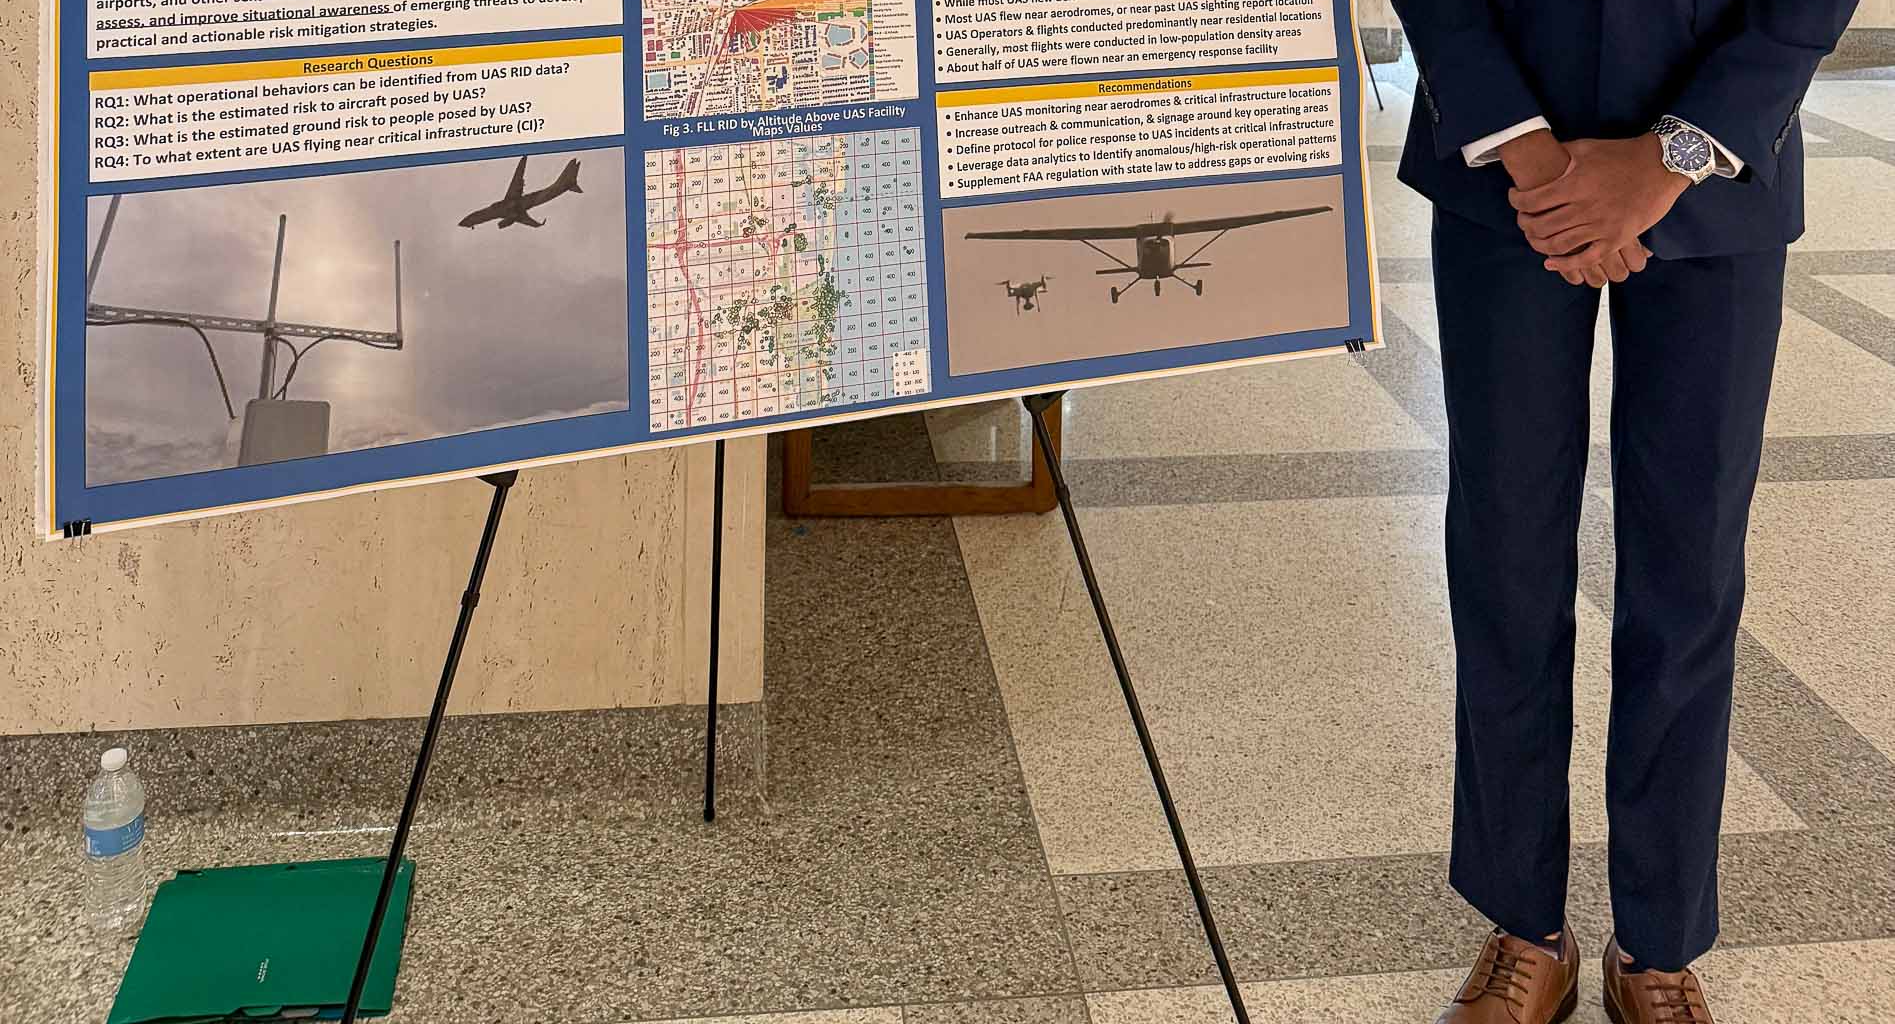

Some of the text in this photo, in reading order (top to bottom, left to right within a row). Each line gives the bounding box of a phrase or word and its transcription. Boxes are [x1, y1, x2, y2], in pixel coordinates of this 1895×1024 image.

[303, 54, 433, 73] Research Questions
[95, 62, 569, 109] RQ1: What operational behaviors can be identified from UAS RID data?
[1098, 79, 1191, 93] Recommendations
[954, 87, 1331, 121] Enhance UAS monitoring near aerodromes & critical infrastructure locations
[663, 106, 905, 136] Fig 3. FLL RID by Altitude Above UAS Facility
[753, 123, 822, 136] Maps Values
